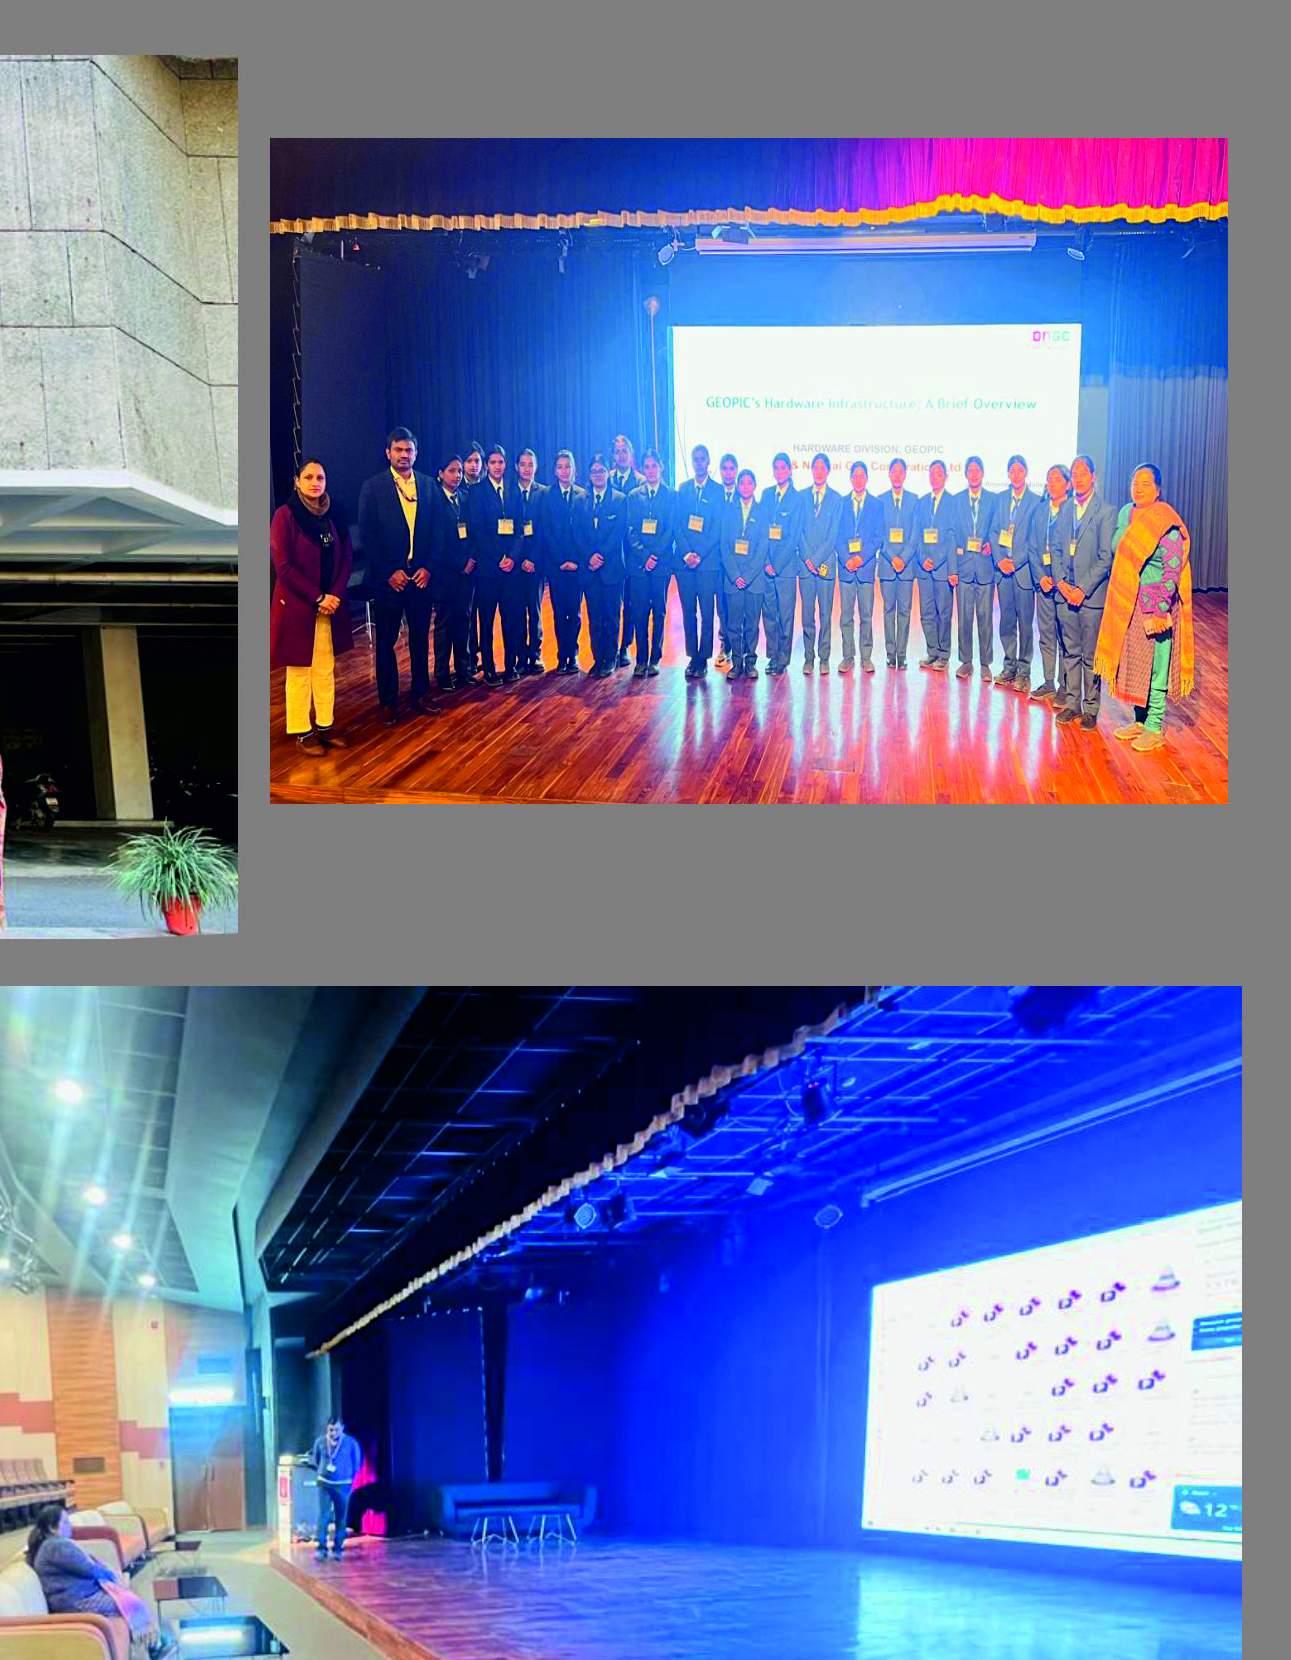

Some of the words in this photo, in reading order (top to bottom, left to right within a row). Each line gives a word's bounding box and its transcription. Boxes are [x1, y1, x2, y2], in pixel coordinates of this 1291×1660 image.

[706, 395, 761, 410] GEOPIC's
[764, 397, 825, 410] Hardware
[925, 398, 934, 410] A
[937, 397, 969, 410] Brief
[973, 397, 1038, 410] Overview
[792, 443, 851, 454] HARDWARE
[904, 444, 945, 455] GEOPIC
